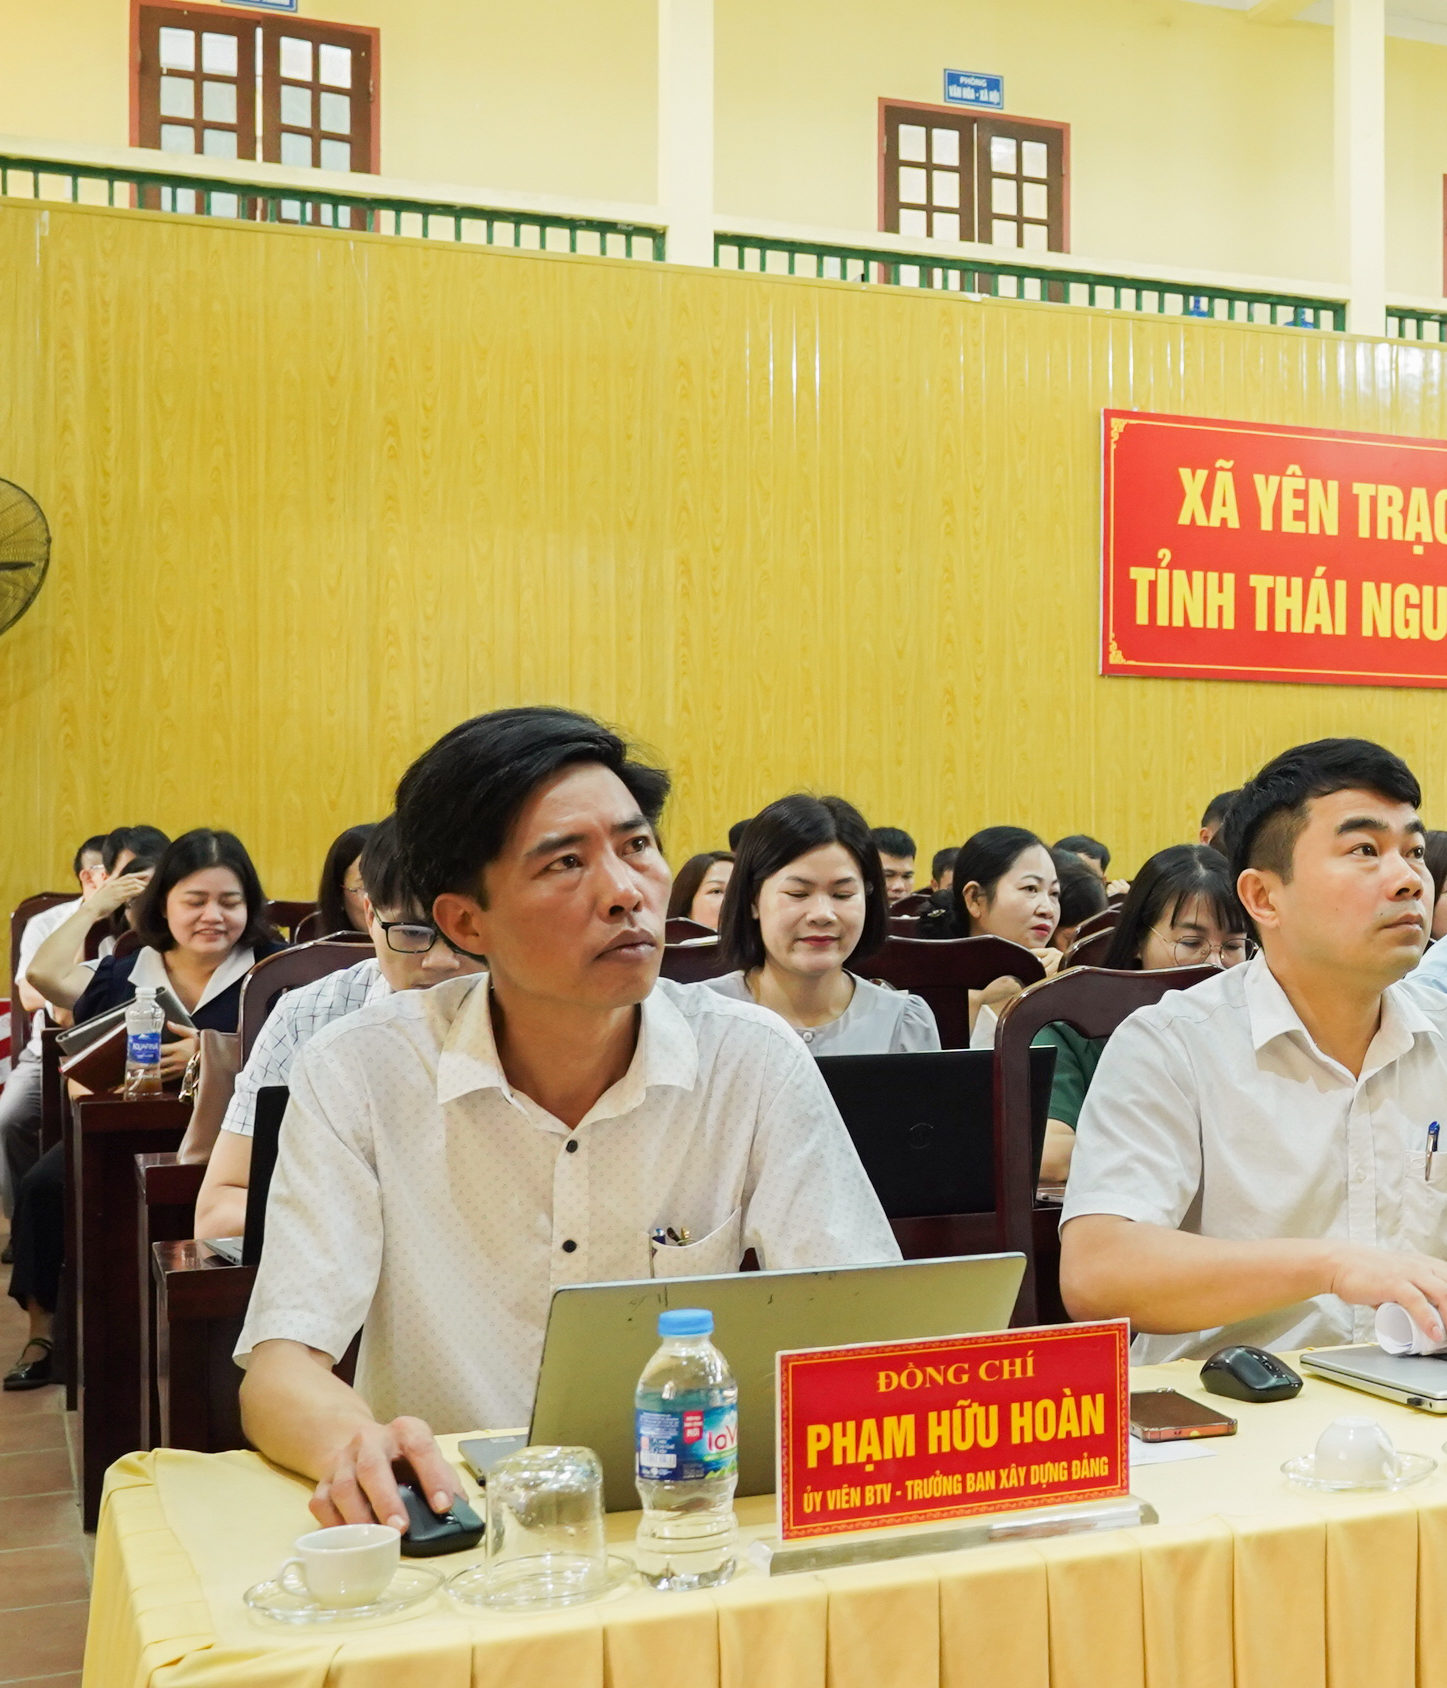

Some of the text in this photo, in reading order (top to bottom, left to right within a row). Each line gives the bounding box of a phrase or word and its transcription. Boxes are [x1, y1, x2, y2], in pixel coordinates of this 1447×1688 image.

[1178, 459, 1239, 529] XÃ
[1253, 464, 1339, 536] YÊN
[1130, 548, 1235, 630] TỈNH
[1249, 566, 1347, 636] THÁI
[979, 1351, 1034, 1380] CHÍ
[807, 1388, 1105, 1472] PHẠM HỮU HOÀN
[803, 1486, 822, 1513] ỦY
[827, 1483, 860, 1511] VIÊN
[865, 1483, 891, 1506] BTV
[906, 1470, 962, 1500] TRƯỞNG
[966, 1470, 995, 1493] BAN
[1000, 1463, 1026, 1489] XÂY
[1031, 1461, 1068, 1488] DỰNG
[1071, 1452, 1108, 1479] ĐẢNG
